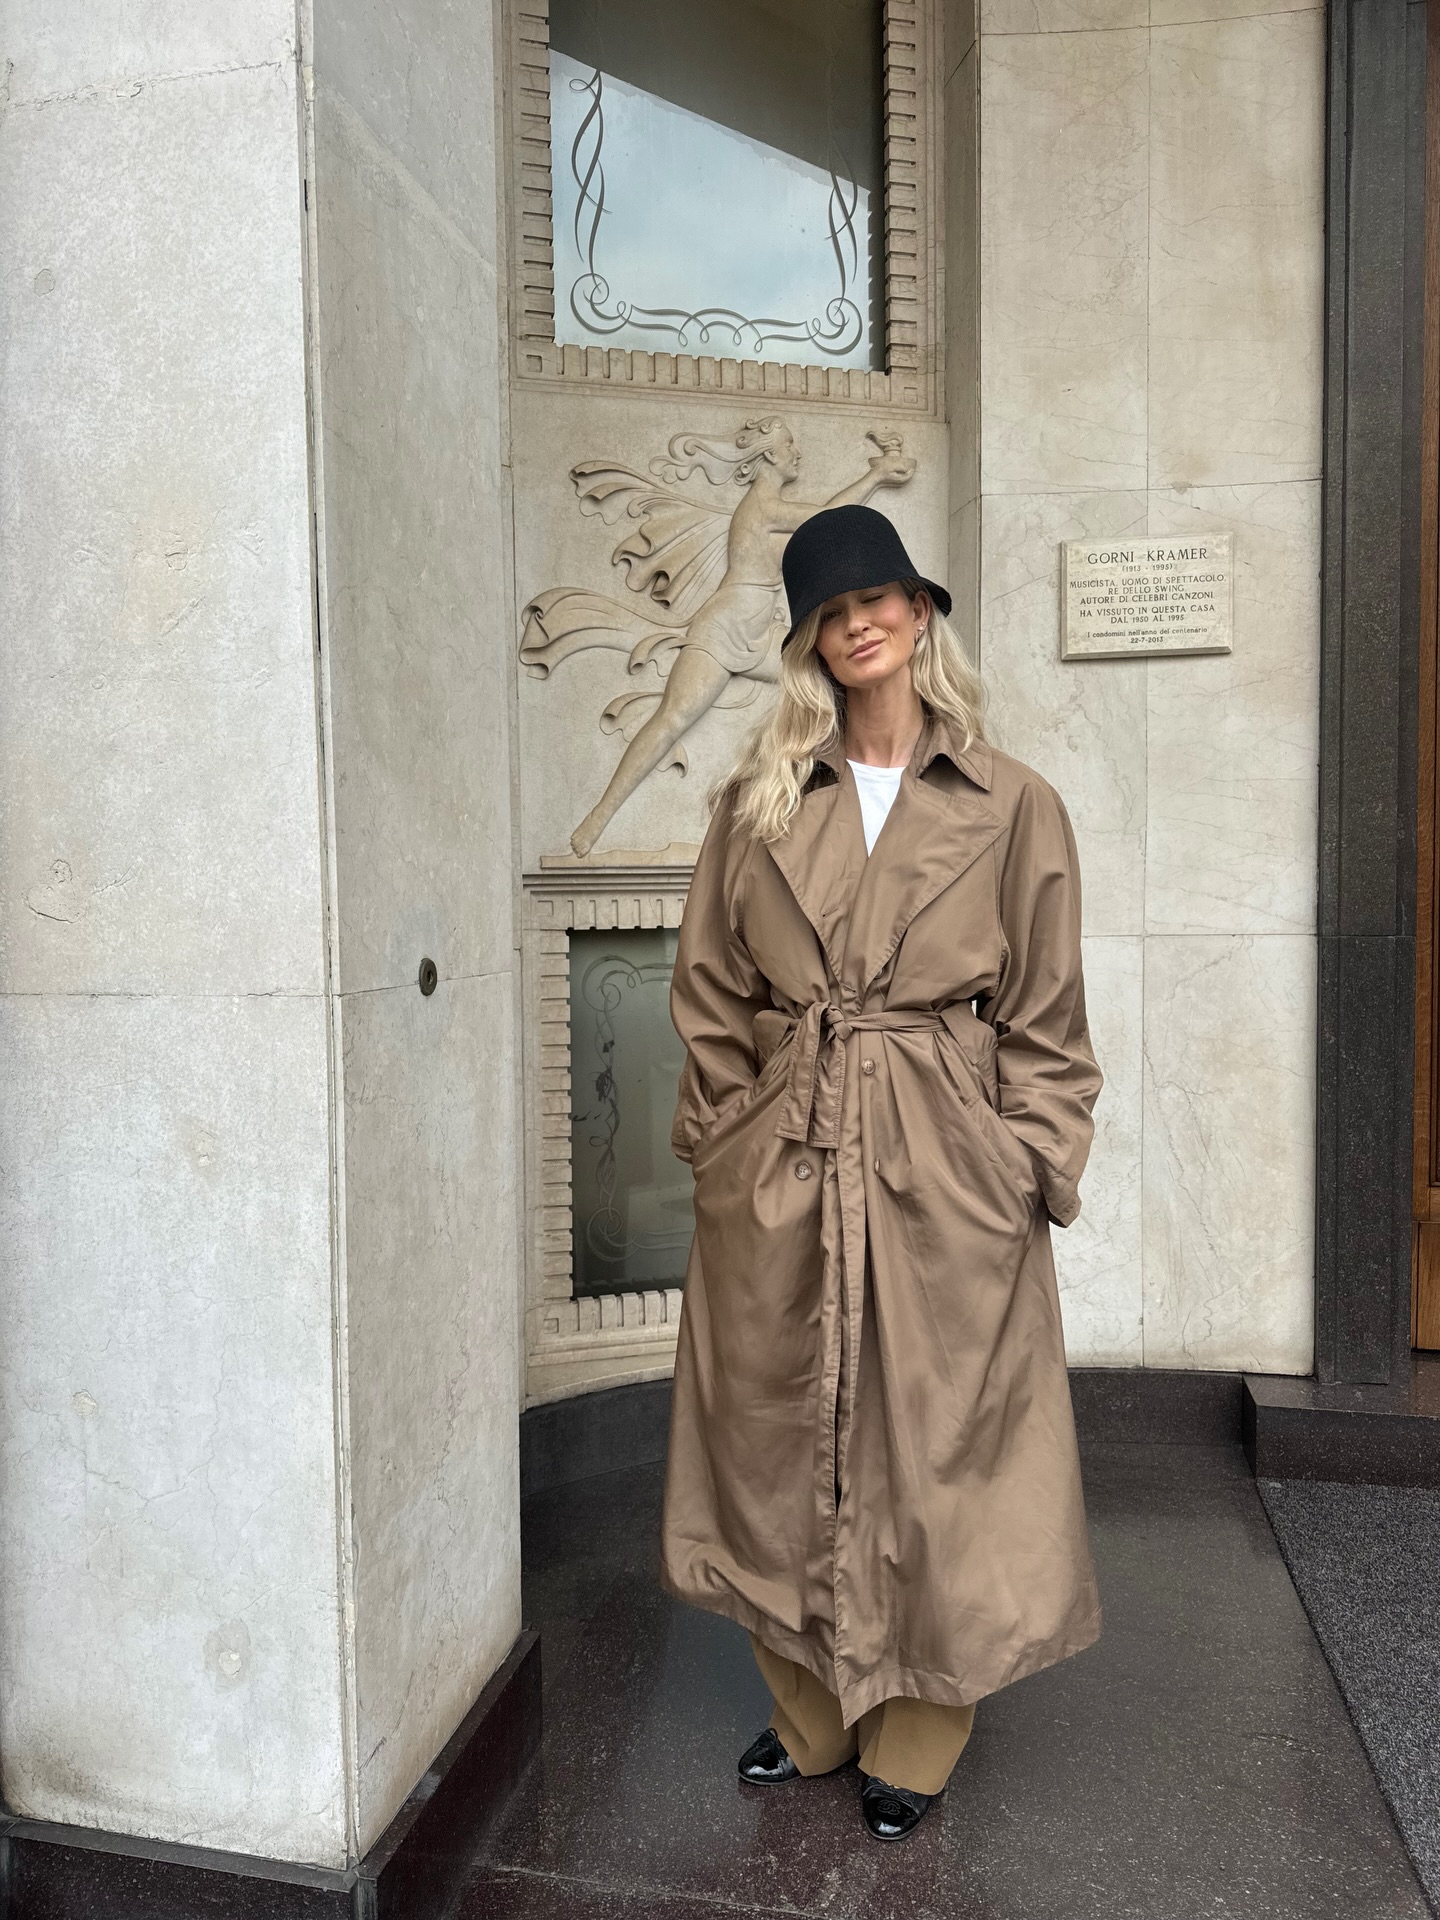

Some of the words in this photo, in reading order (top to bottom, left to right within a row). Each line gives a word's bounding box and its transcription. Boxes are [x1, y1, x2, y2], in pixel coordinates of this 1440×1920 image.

[1087, 552, 1134, 565] GORNI
[1147, 548, 1208, 562] KRAMER
[1152, 563, 1173, 571] 1995)
[1122, 577, 1149, 586] UOMO
[1153, 576, 1162, 585] DI
[1108, 587, 1119, 595] RE
[1123, 586, 1151, 595] DELLO
[1080, 596, 1115, 605] AUTORE
[1119, 595, 1128, 603] DI
[1131, 593, 1168, 603] CELEBRI
[1080, 609, 1093, 618] HA
[1096, 607, 1135, 617] VISSUTO
[1138, 607, 1148, 615] IN
[1151, 605, 1187, 614] QUESTA
[1190, 604, 1215, 612] CASA
[1110, 616, 1128, 624] DAL
[1168, 614, 1185, 622] 1995
[1171, 627, 1208, 635] centenario
[1130, 636, 1164, 644] 22-7-2013
